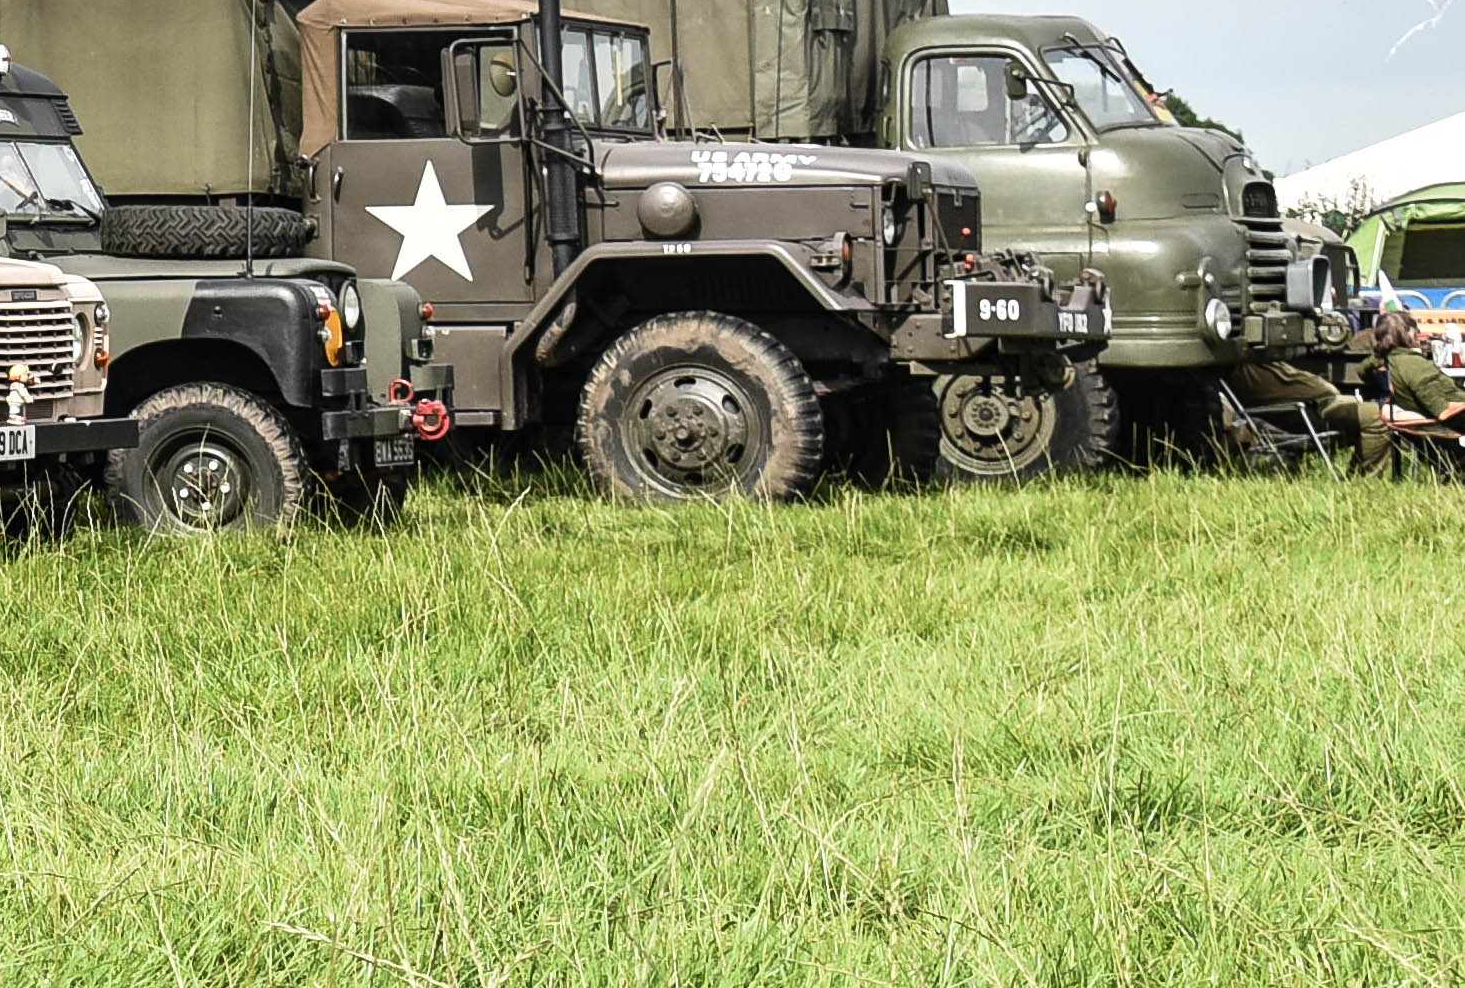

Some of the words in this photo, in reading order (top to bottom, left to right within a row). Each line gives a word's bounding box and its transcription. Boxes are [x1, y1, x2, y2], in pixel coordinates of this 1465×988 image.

[690, 150, 728, 163] US
[733, 151, 817, 165] ARMY
[8, 430, 28, 455] DCA
